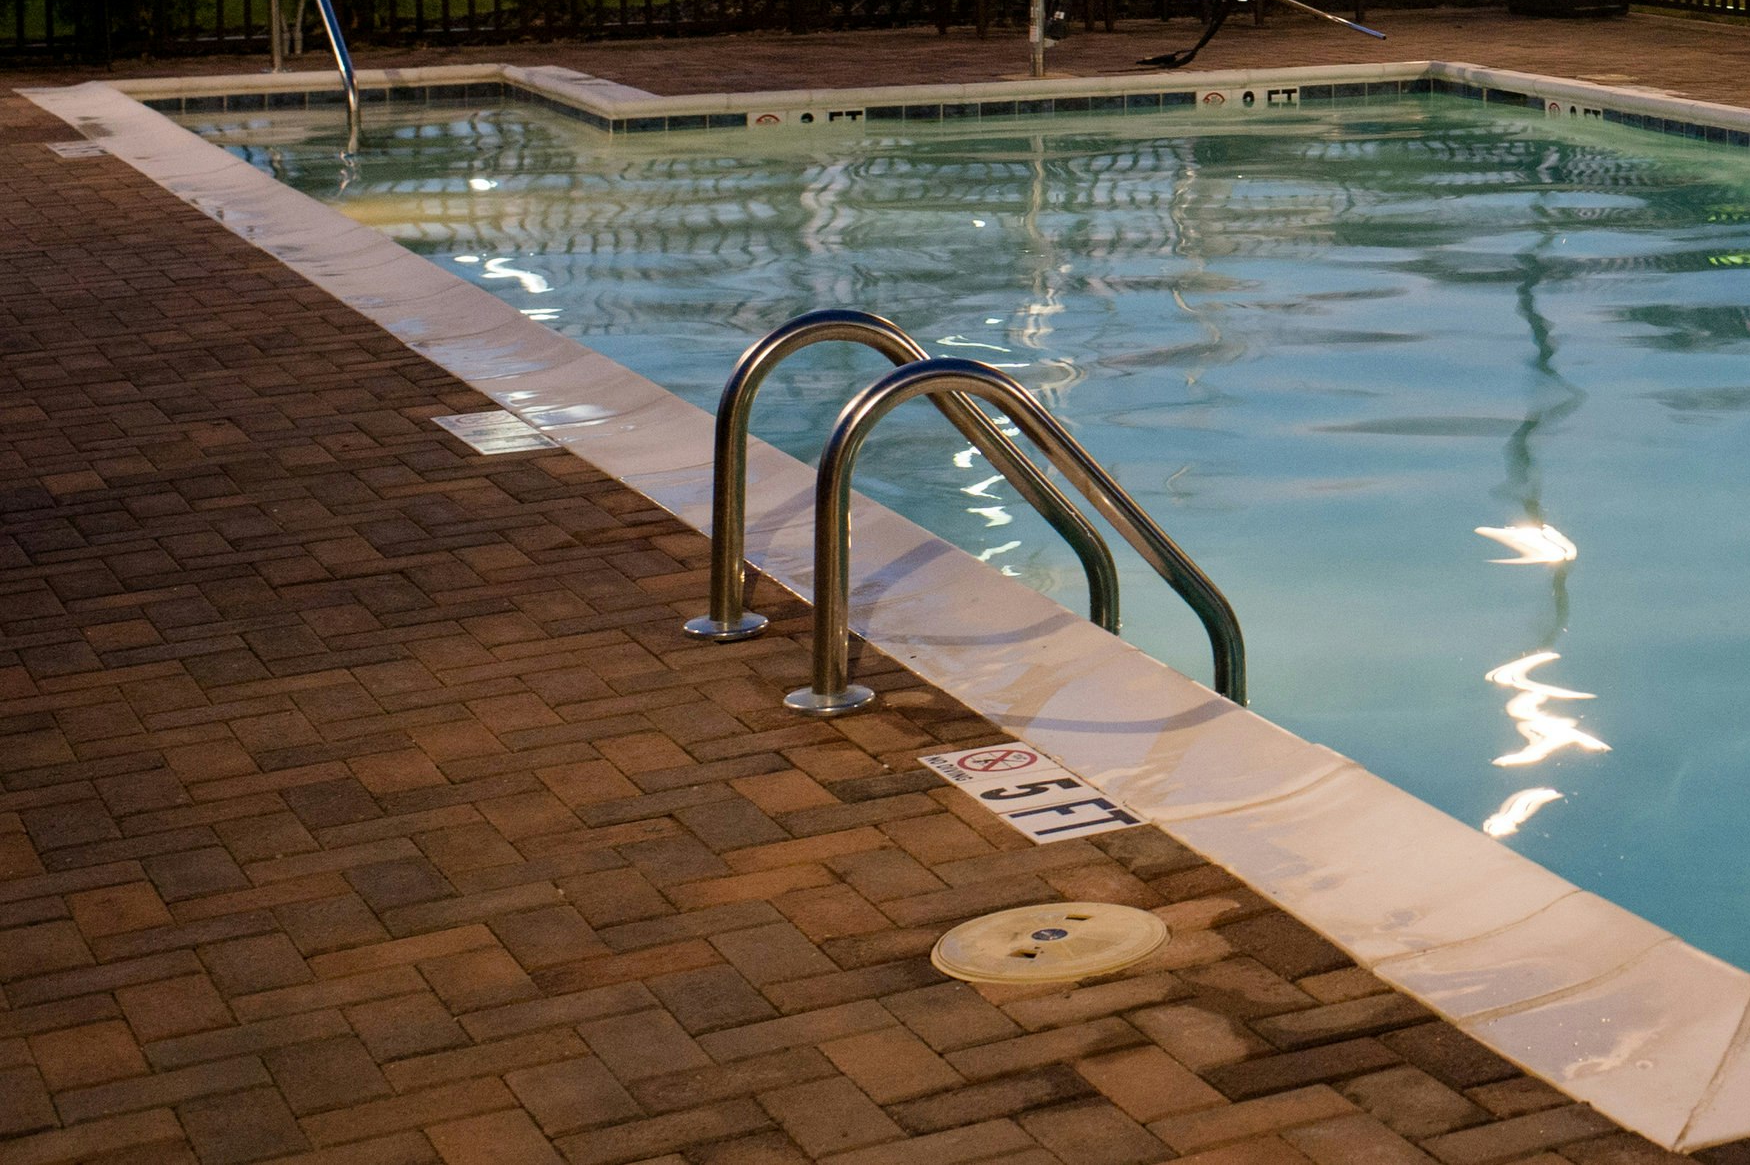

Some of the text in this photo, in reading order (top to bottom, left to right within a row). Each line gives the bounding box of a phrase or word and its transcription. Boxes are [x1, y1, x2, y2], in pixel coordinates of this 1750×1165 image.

[925, 756, 974, 781] NO DIVING
[980, 777, 1141, 836] 5 FT
